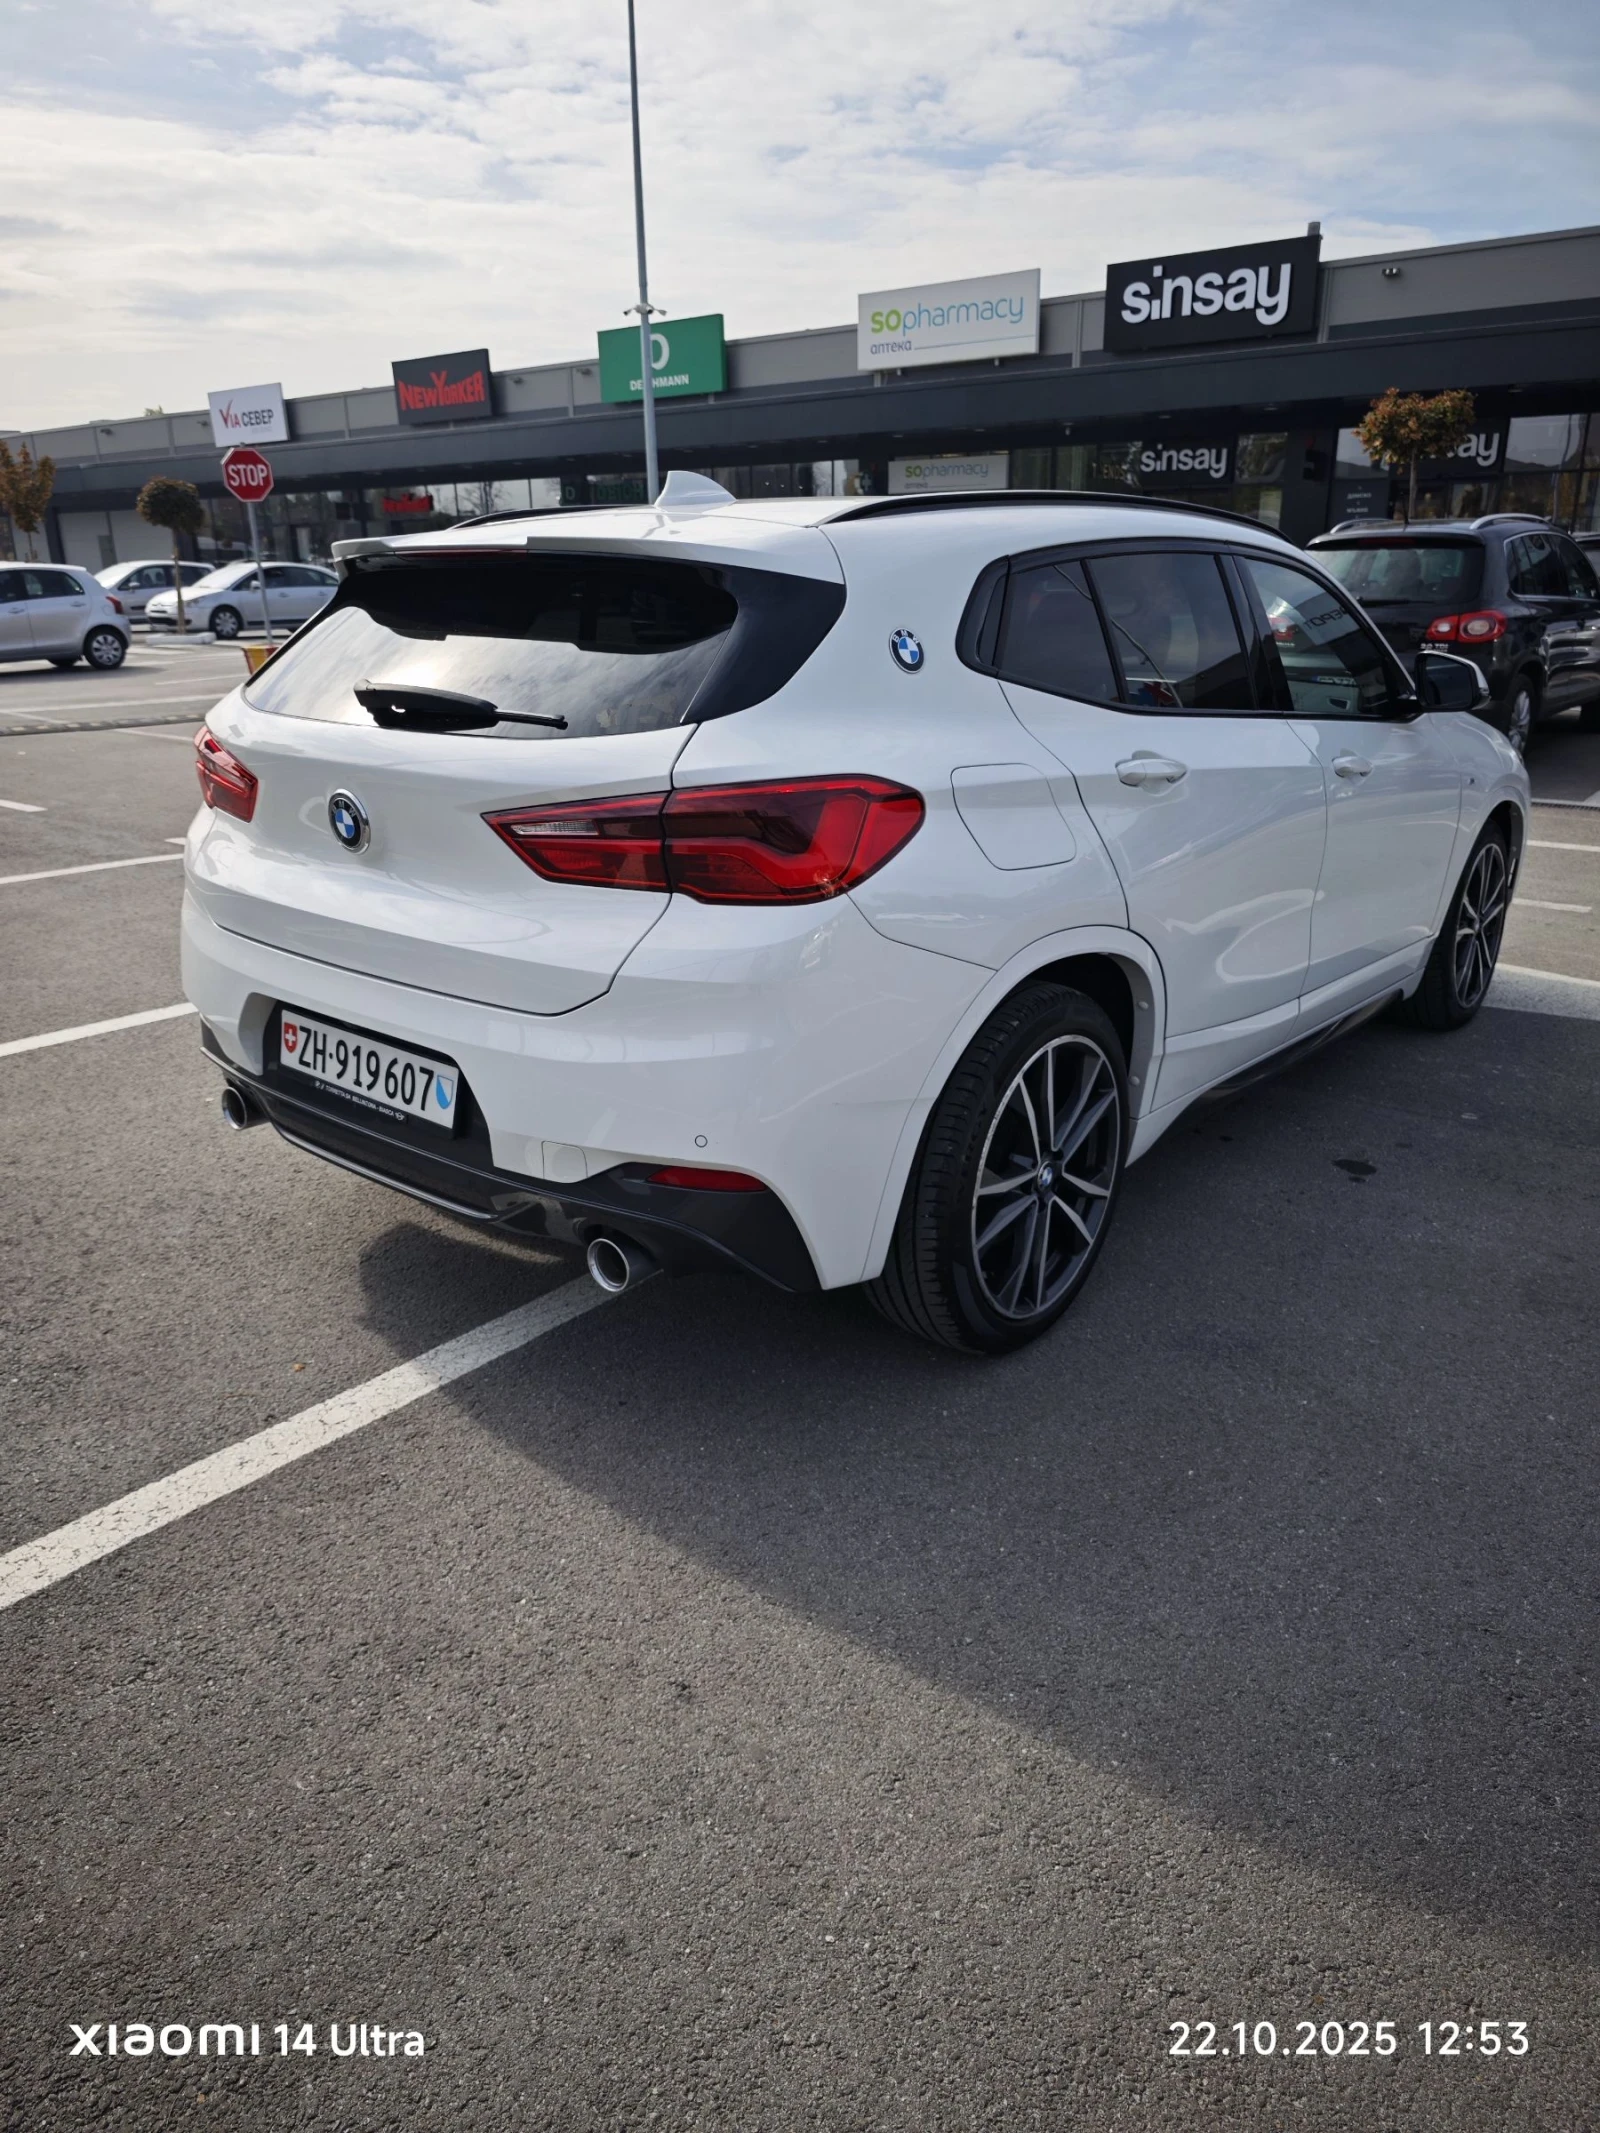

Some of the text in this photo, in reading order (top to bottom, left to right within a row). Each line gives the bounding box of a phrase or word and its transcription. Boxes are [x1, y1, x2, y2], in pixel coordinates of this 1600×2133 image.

[1121, 263, 1292, 326] sinsay
[870, 296, 1025, 337] sopharmacy
[870, 340, 913, 355] аптека
[629, 374, 690, 391] DEHMANN
[1140, 443, 1227, 479] sinsay
[228, 464, 268, 487] STOP
[905, 463, 989, 479] sopharmacy
[892, 629, 921, 645] BMW
[331, 799, 357, 818] BMW
